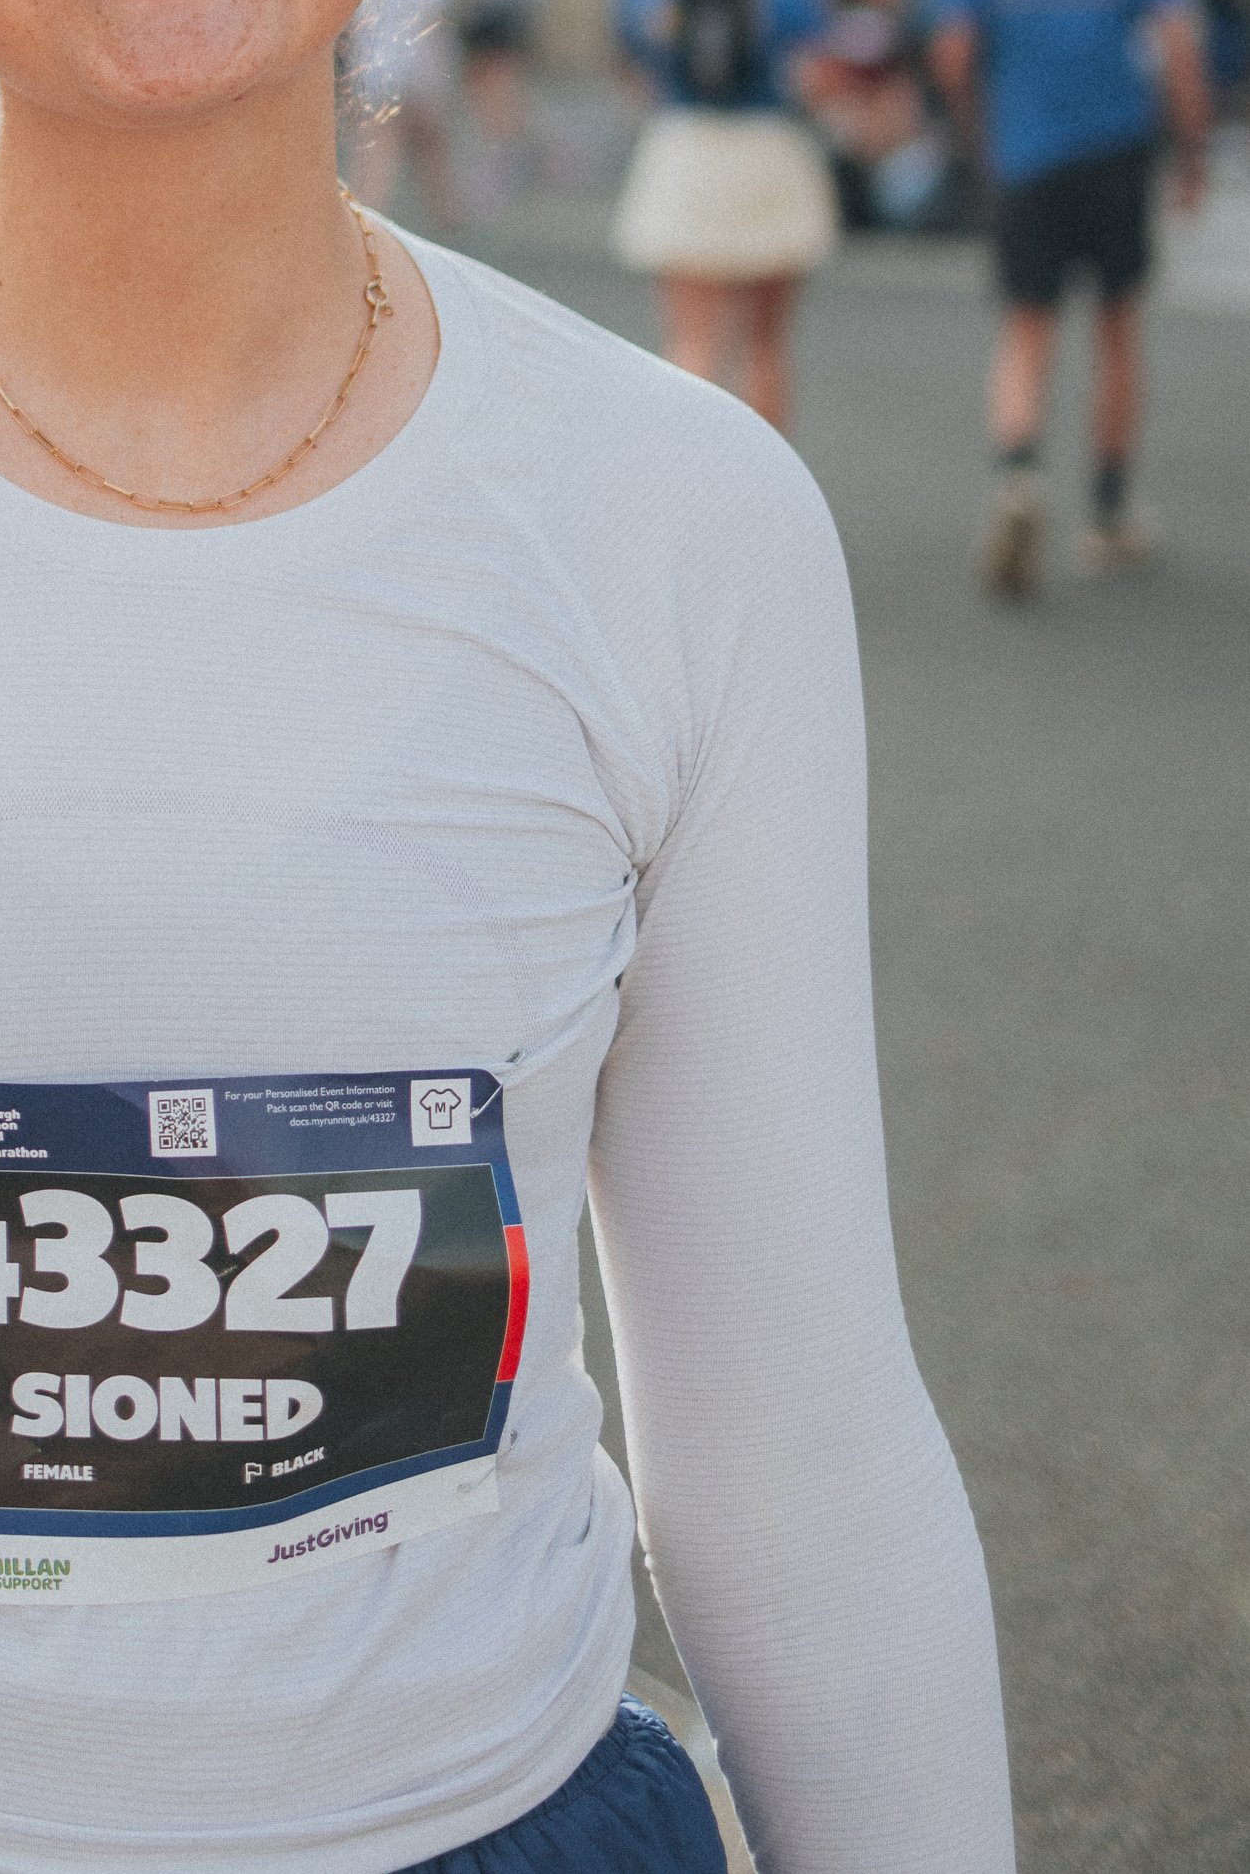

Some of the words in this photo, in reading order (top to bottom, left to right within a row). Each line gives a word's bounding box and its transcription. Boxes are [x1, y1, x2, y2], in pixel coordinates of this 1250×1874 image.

[225, 1091, 241, 1101] For
[242, 1091, 263, 1102] your
[265, 1087, 318, 1099] Personalised
[320, 1086, 344, 1097] Event
[346, 1085, 395, 1096] Information
[267, 1103, 287, 1113] Pack
[289, 1103, 308, 1113] scan
[309, 1102, 324, 1111] the
[325, 1100, 340, 1112] QR
[341, 1099, 362, 1110] code
[364, 1100, 375, 1109] or
[376, 1099, 393, 1109] visit
[434, 1101, 446, 1114] M
[289, 1112, 395, 1127] docs.myrunning.uk/43327
[10, 1371, 324, 1442] SIONED
[270, 1445, 326, 1477] BLACK
[22, 1463, 94, 1482] FEMALE
[266, 1511, 390, 1564] JustGiving
